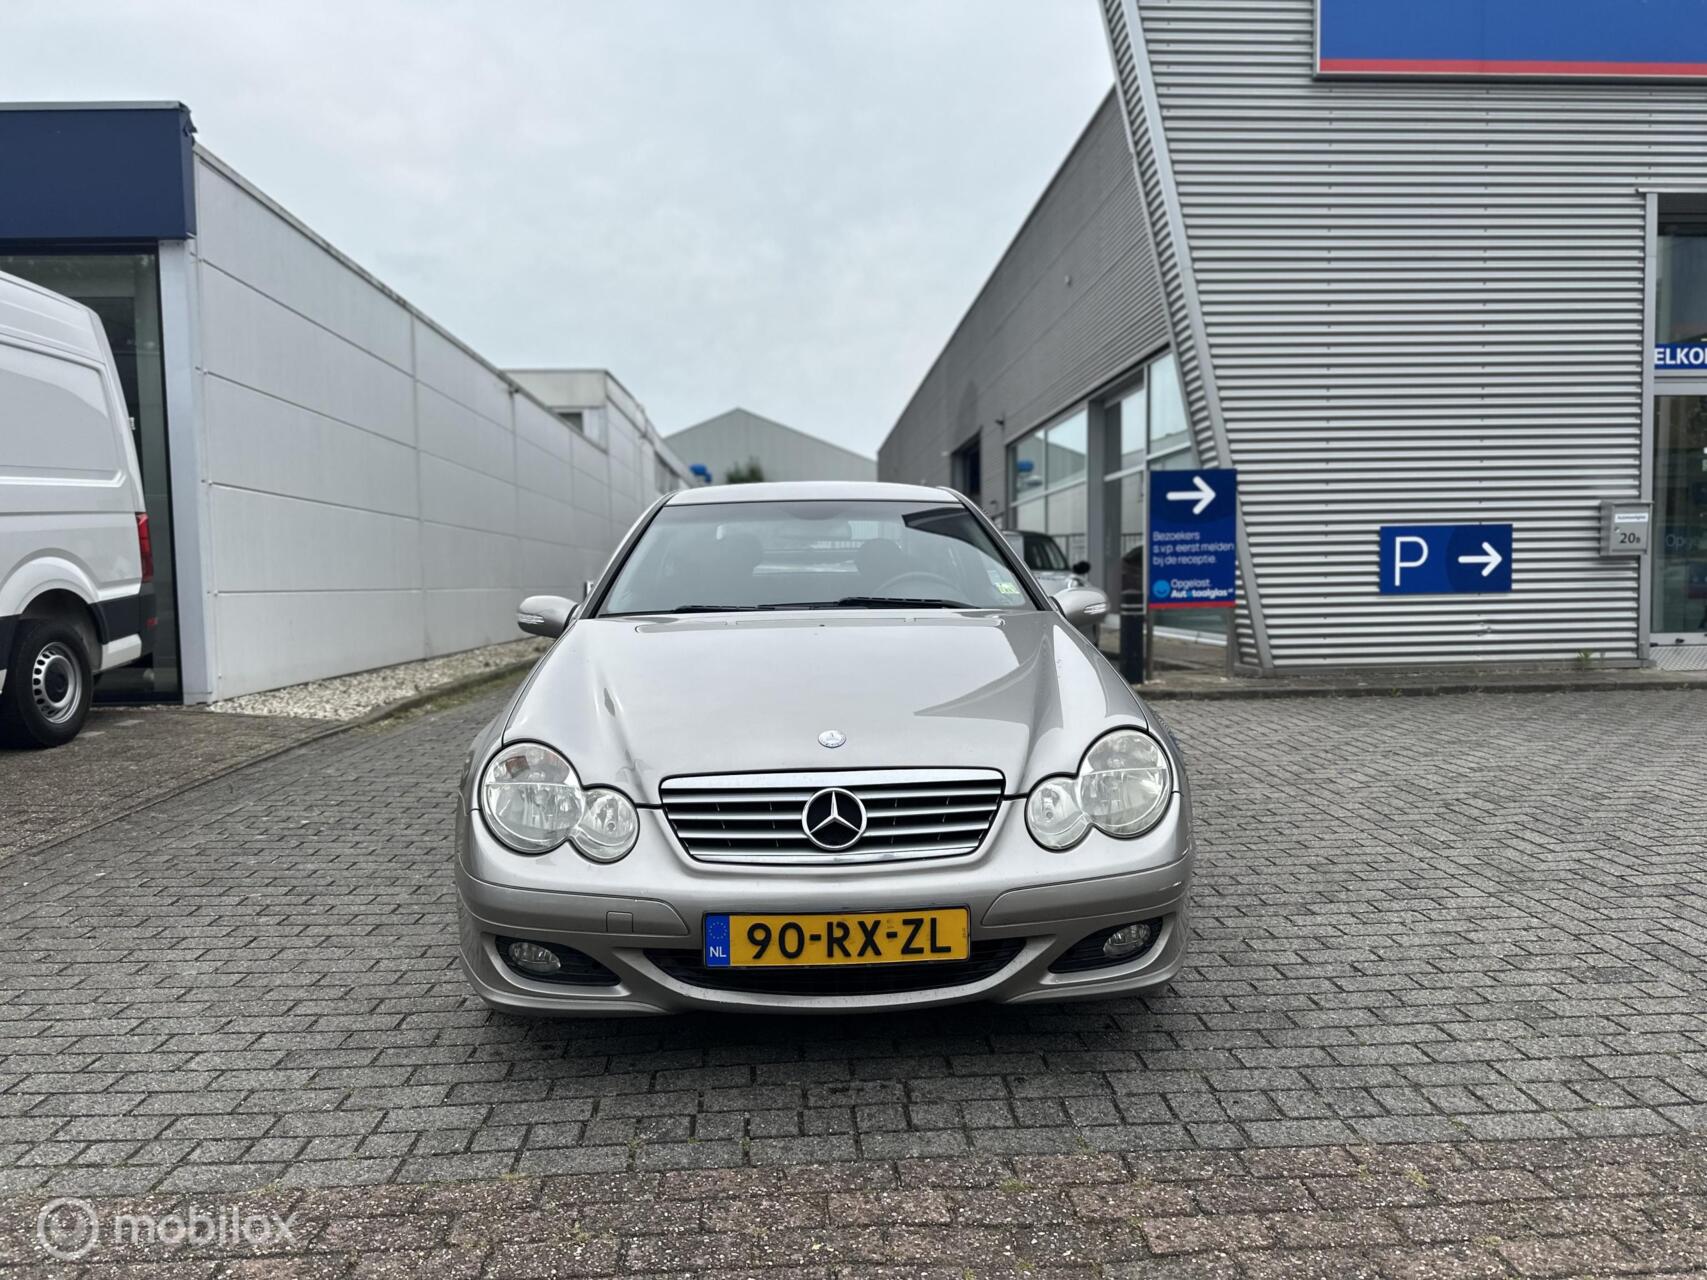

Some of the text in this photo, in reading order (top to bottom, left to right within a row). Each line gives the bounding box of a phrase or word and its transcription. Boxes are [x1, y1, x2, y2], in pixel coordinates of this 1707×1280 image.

[1654, 347, 1707, 365] ELKO
[1176, 543, 1200, 552] eerst
[1165, 555, 1177, 565] de
[1395, 536, 1429, 586] P
[747, 917, 952, 960] 90-RX-ZL
[709, 946, 727, 958] NL
